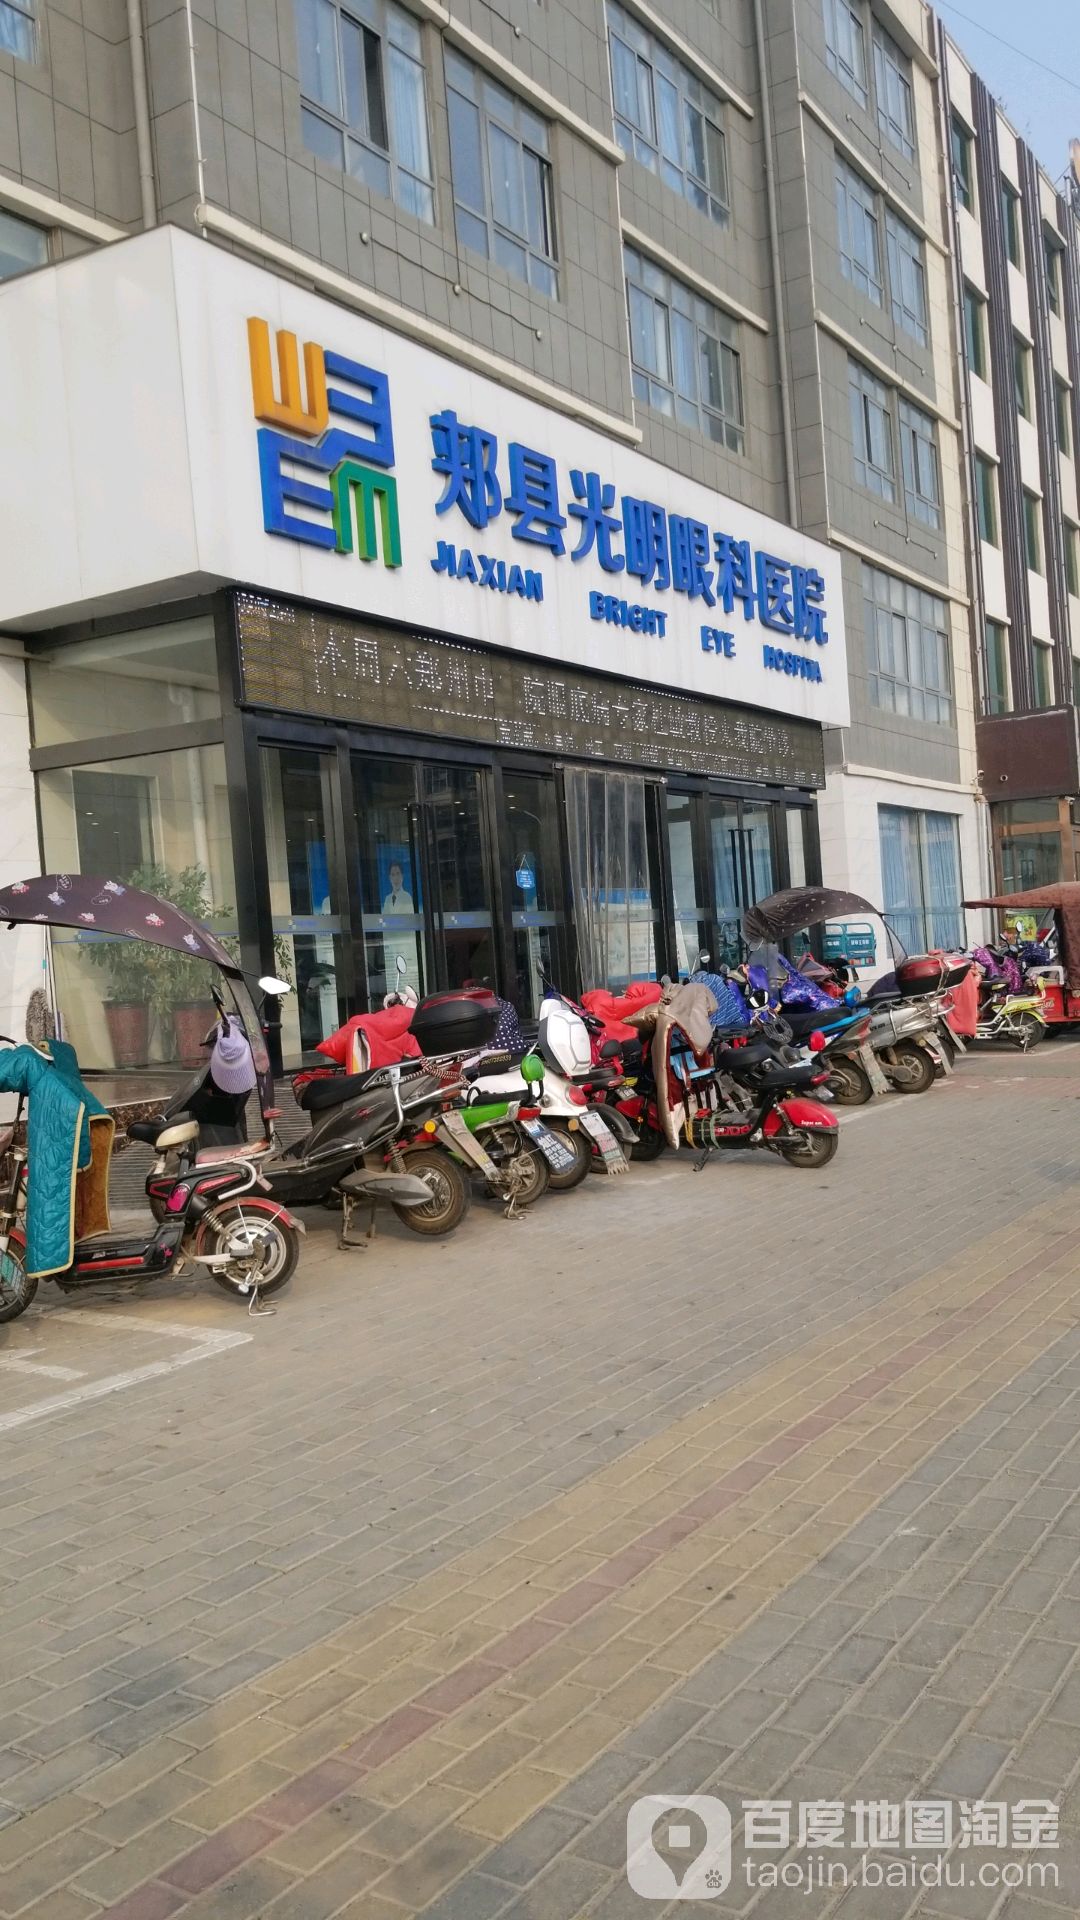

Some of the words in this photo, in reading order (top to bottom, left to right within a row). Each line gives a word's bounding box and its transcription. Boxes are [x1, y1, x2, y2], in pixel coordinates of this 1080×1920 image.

[430, 409, 829, 645] 郏县光明眼科医院
[430, 540, 544, 605] JIAXIAN
[589, 590, 668, 638] BRIGHT
[700, 625, 736, 658] EYE
